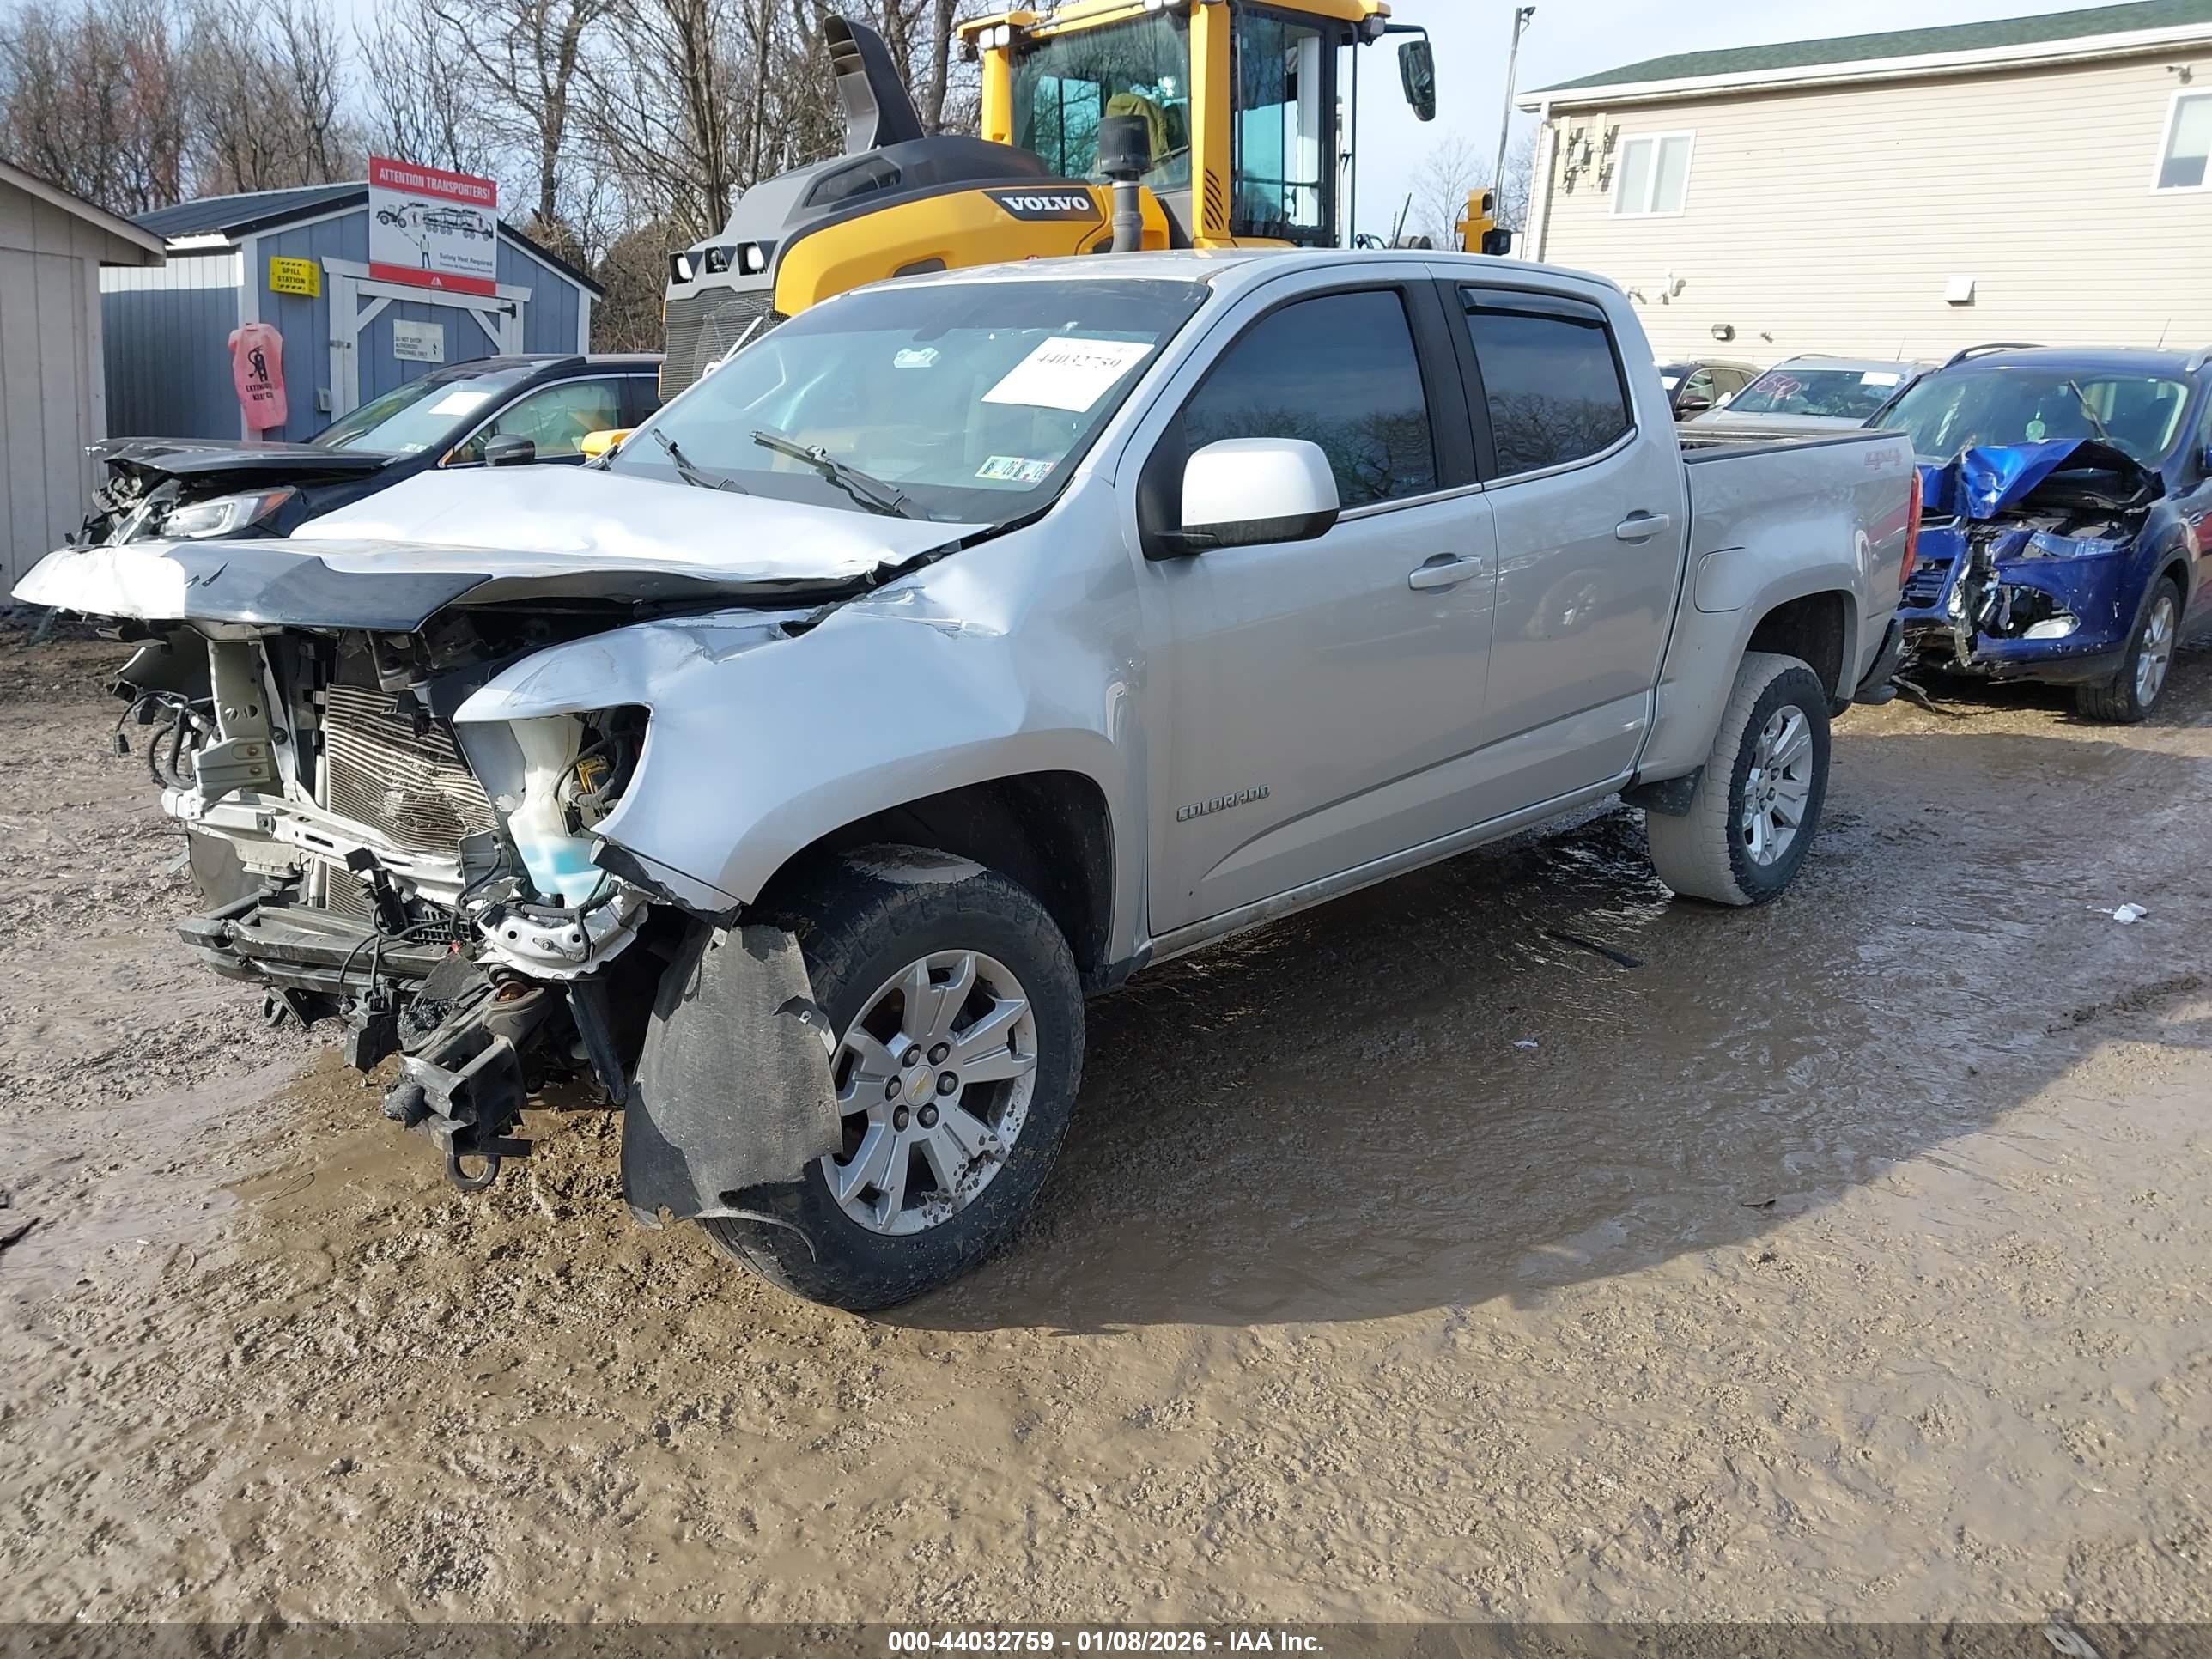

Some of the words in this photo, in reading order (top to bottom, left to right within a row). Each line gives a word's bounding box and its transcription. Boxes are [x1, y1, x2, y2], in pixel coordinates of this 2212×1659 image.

[379, 167, 425, 187] ATTENTION
[426, 176, 491, 200] TRANSPORTERS!
[1000, 196, 1090, 211] VOLVO
[282, 267, 301, 276] SPILL
[277, 275, 306, 284] STATION
[1176, 783, 1270, 822] COLORADO
